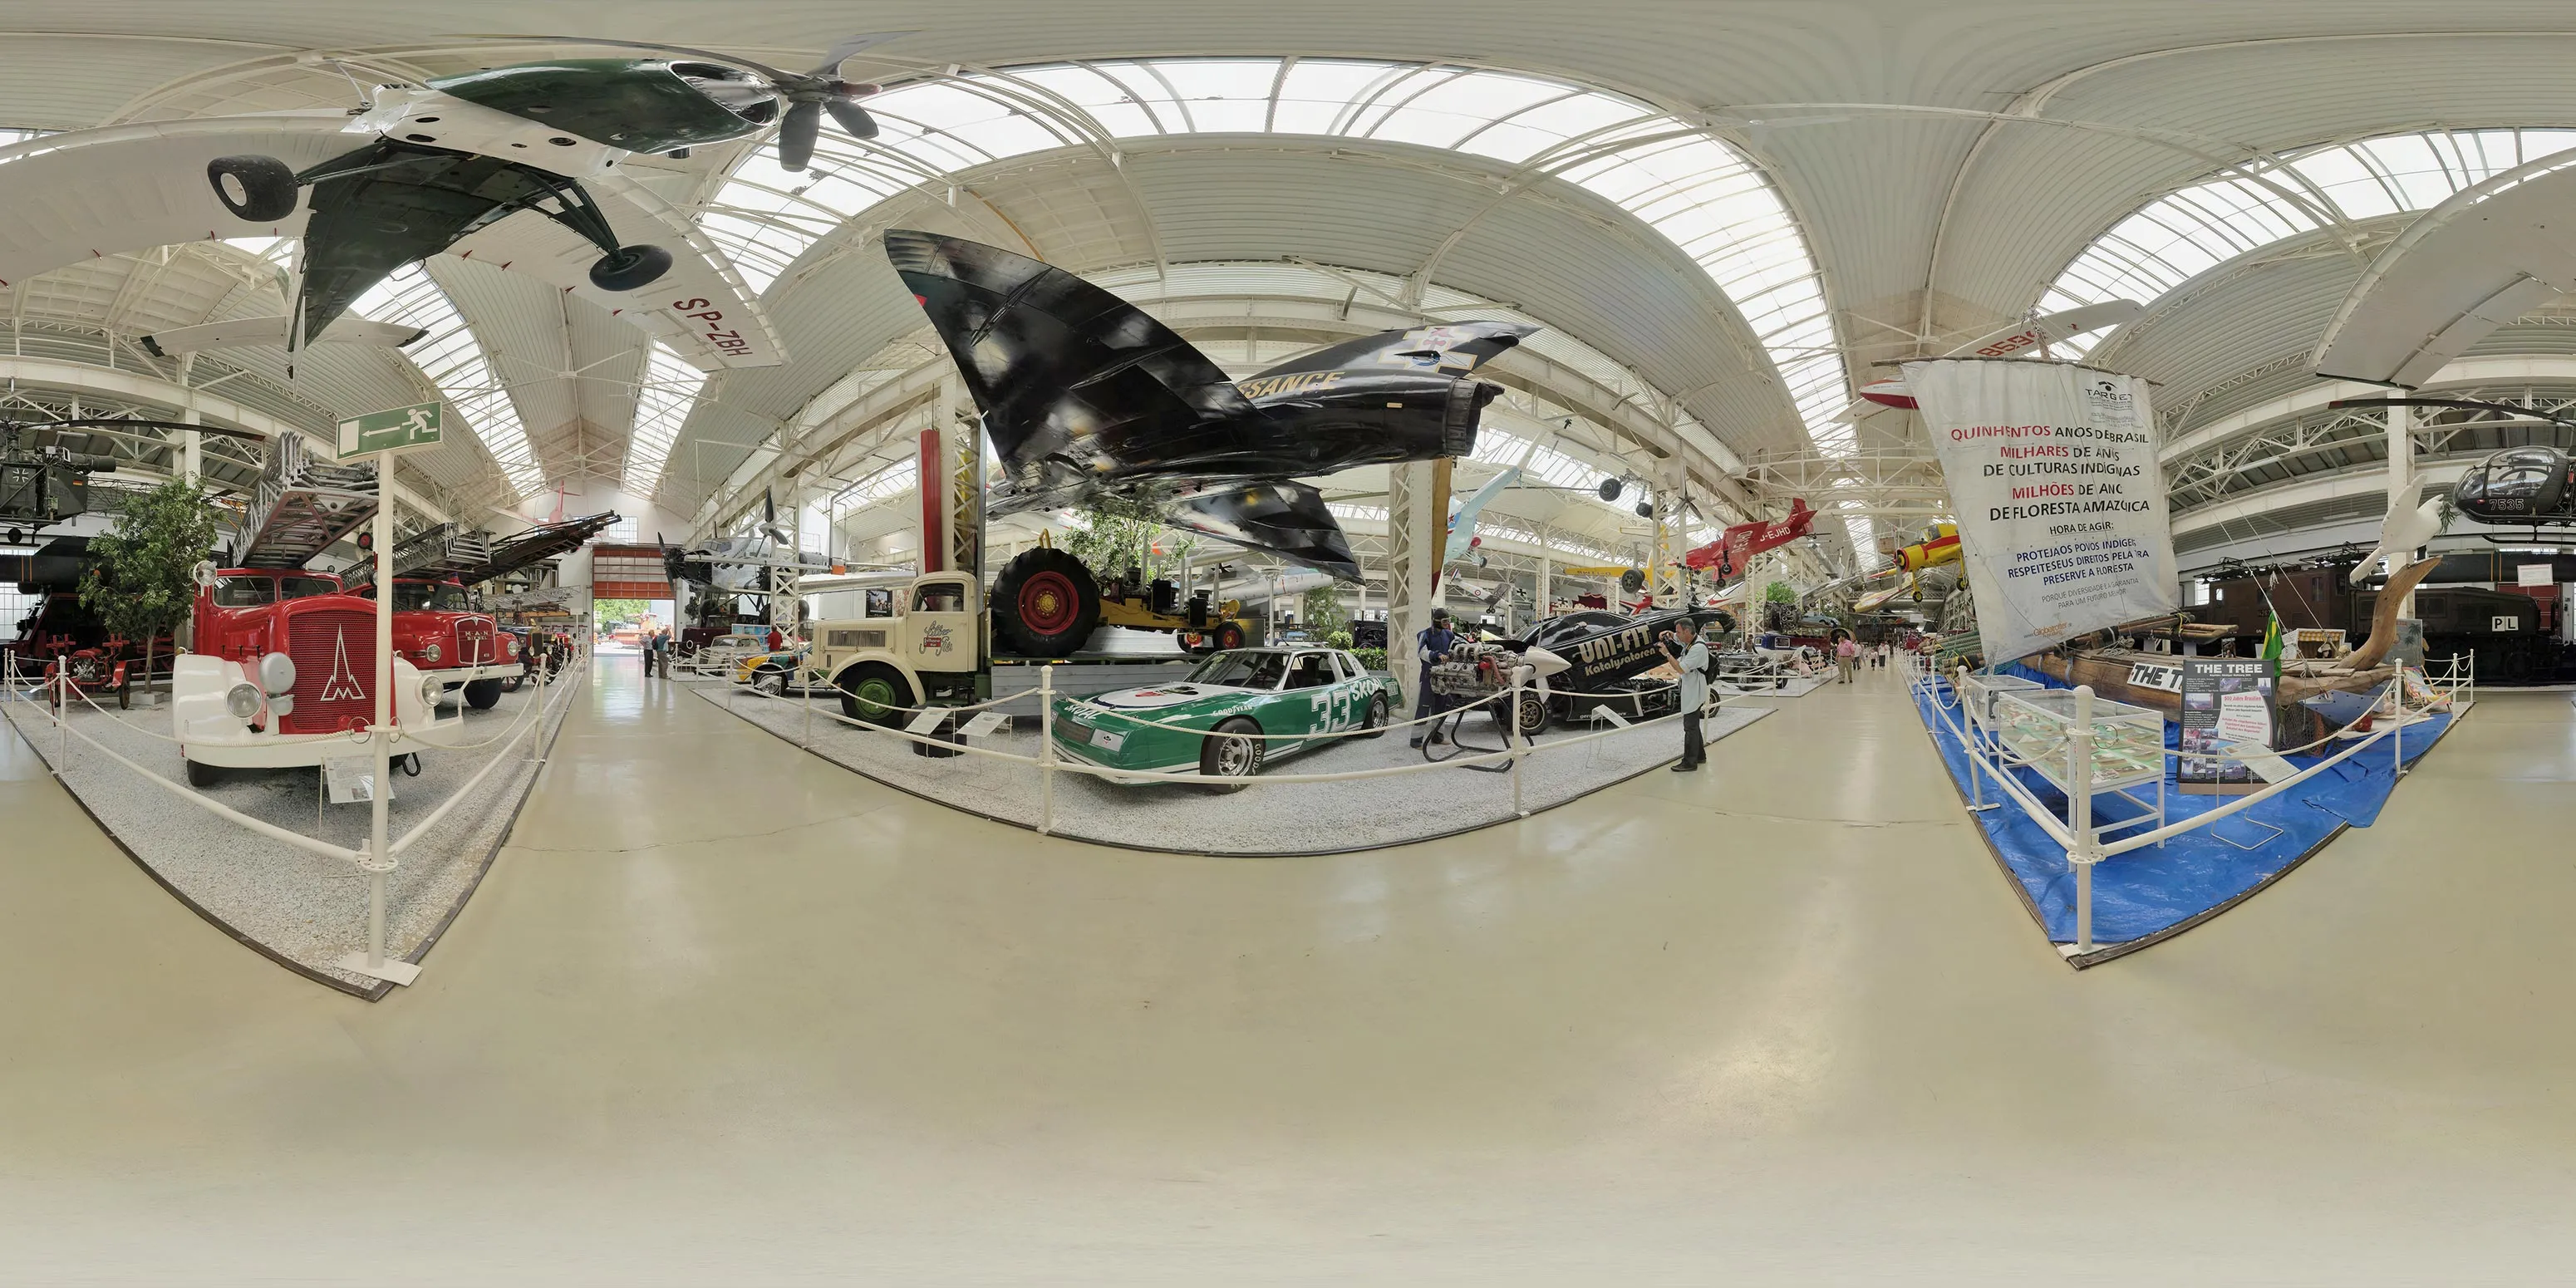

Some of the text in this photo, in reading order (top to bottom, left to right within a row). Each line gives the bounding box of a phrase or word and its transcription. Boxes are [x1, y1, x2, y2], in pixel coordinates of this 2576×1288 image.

[673, 297, 753, 356] SP-ZBH
[1950, 425, 2051, 442] QUINHENTOS
[2054, 426, 2093, 438] ANOS
[2000, 445, 2069, 459] MILHARES
[2073, 446, 2092, 458] DE
[1984, 464, 2004, 477] DE
[2008, 462, 2077, 476] CULTURAS
[2013, 481, 2074, 499] MILHÕES
[2078, 484, 2094, 495] DE
[1990, 508, 2010, 521] DE
[2013, 502, 2081, 519] FLORESTA
[2489, 499, 2524, 511] 7535
[2049, 521, 2114, 534] HORA DE AGIR:
[2074, 542, 2100, 553] POVOS
[2076, 553, 2109, 566] DIREITOS
[2112, 550, 2133, 561] PELA
[2043, 563, 2134, 585] PRESERVE A FLORESTA
[2042, 591, 2067, 603] PORQUE
[2067, 583, 2104, 597] DIVERSIDADE
[2057, 601, 2074, 609] PARA
[2076, 597, 2087, 606] UM
[2087, 592, 2108, 604] FUTURO
[1585, 647, 1656, 676] Katalysatoren
[2195, 664, 2263, 674] THE TREE
[2132, 664, 2169, 686] THE
[1306, 688, 1351, 742] 33
